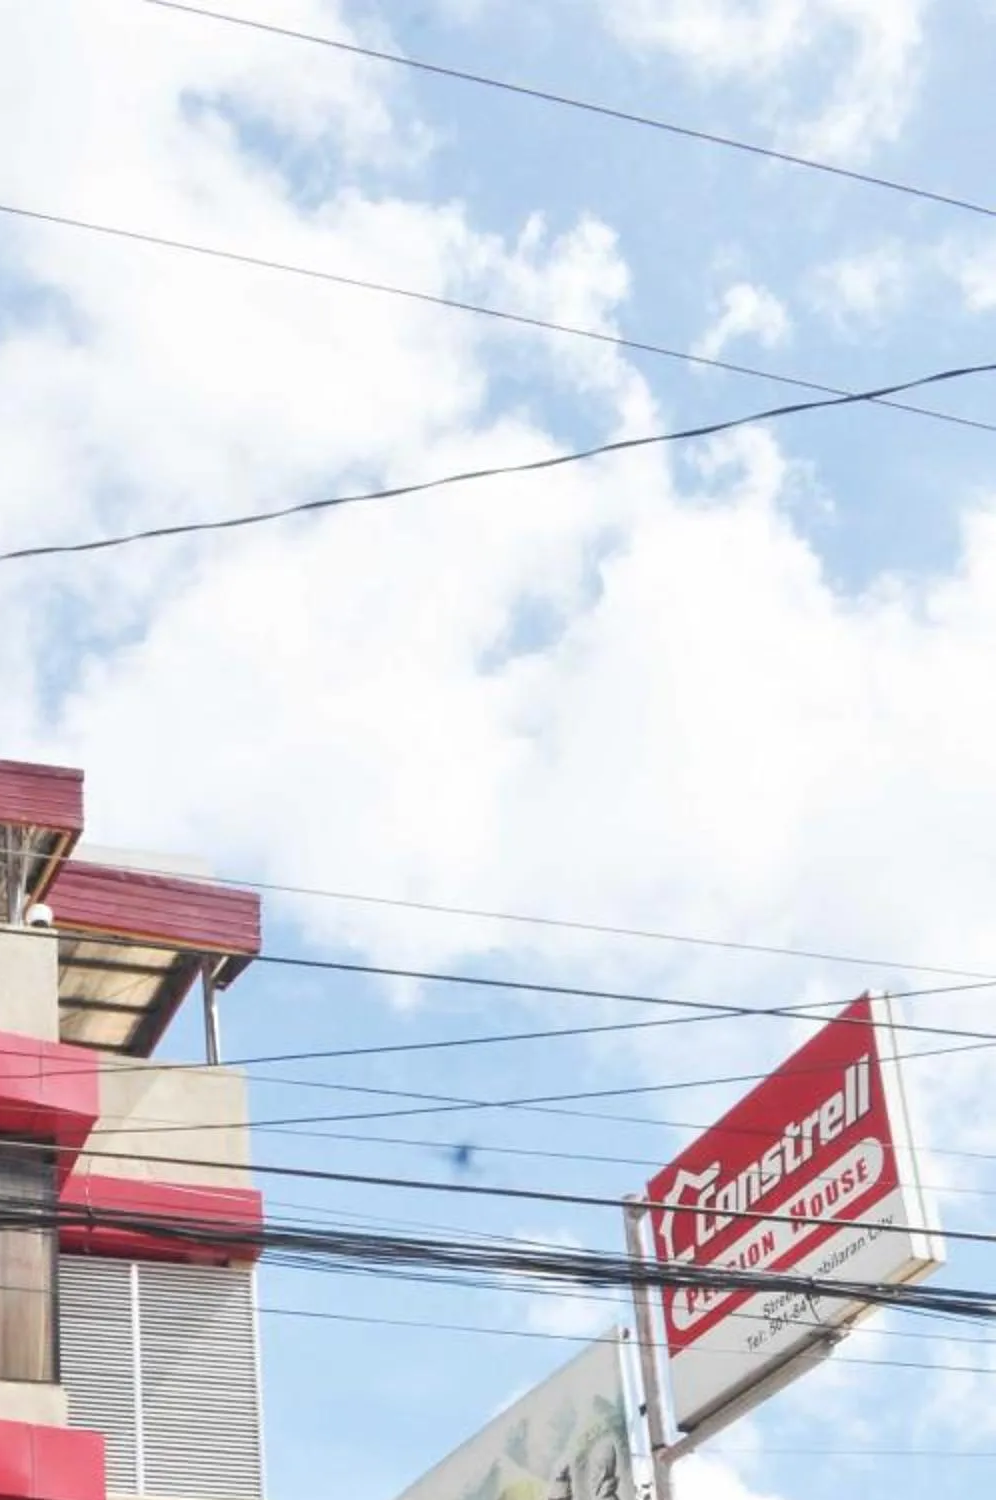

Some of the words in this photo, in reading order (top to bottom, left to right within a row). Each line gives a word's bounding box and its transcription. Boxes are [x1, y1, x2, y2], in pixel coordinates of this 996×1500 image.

[686, 1231, 775, 1315] PION
[790, 1156, 870, 1234] HOUSE
[695, 1053, 871, 1247] Constrell
